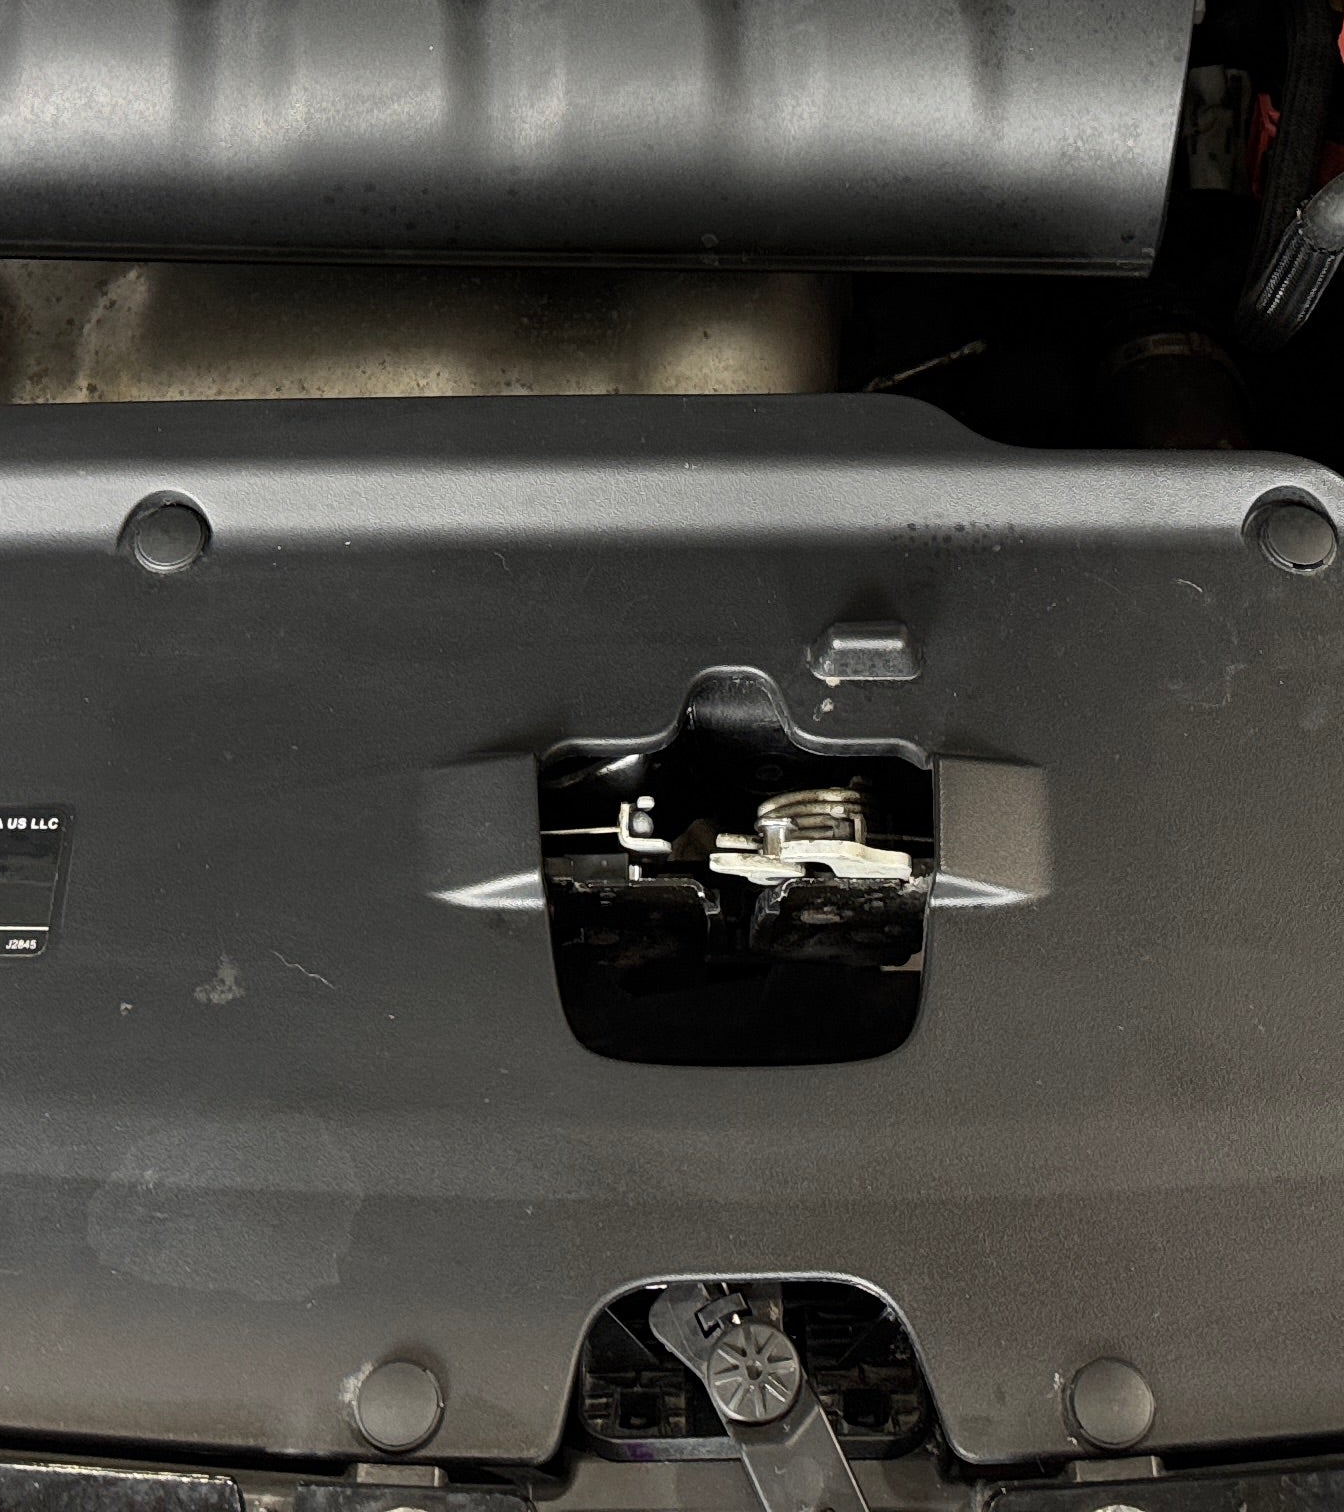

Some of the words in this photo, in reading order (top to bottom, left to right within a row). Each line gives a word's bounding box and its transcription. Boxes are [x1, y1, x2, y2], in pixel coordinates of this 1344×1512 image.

[6, 816, 27, 831] US
[29, 816, 60, 831] LLC
[4, 939, 38, 950] J2845
